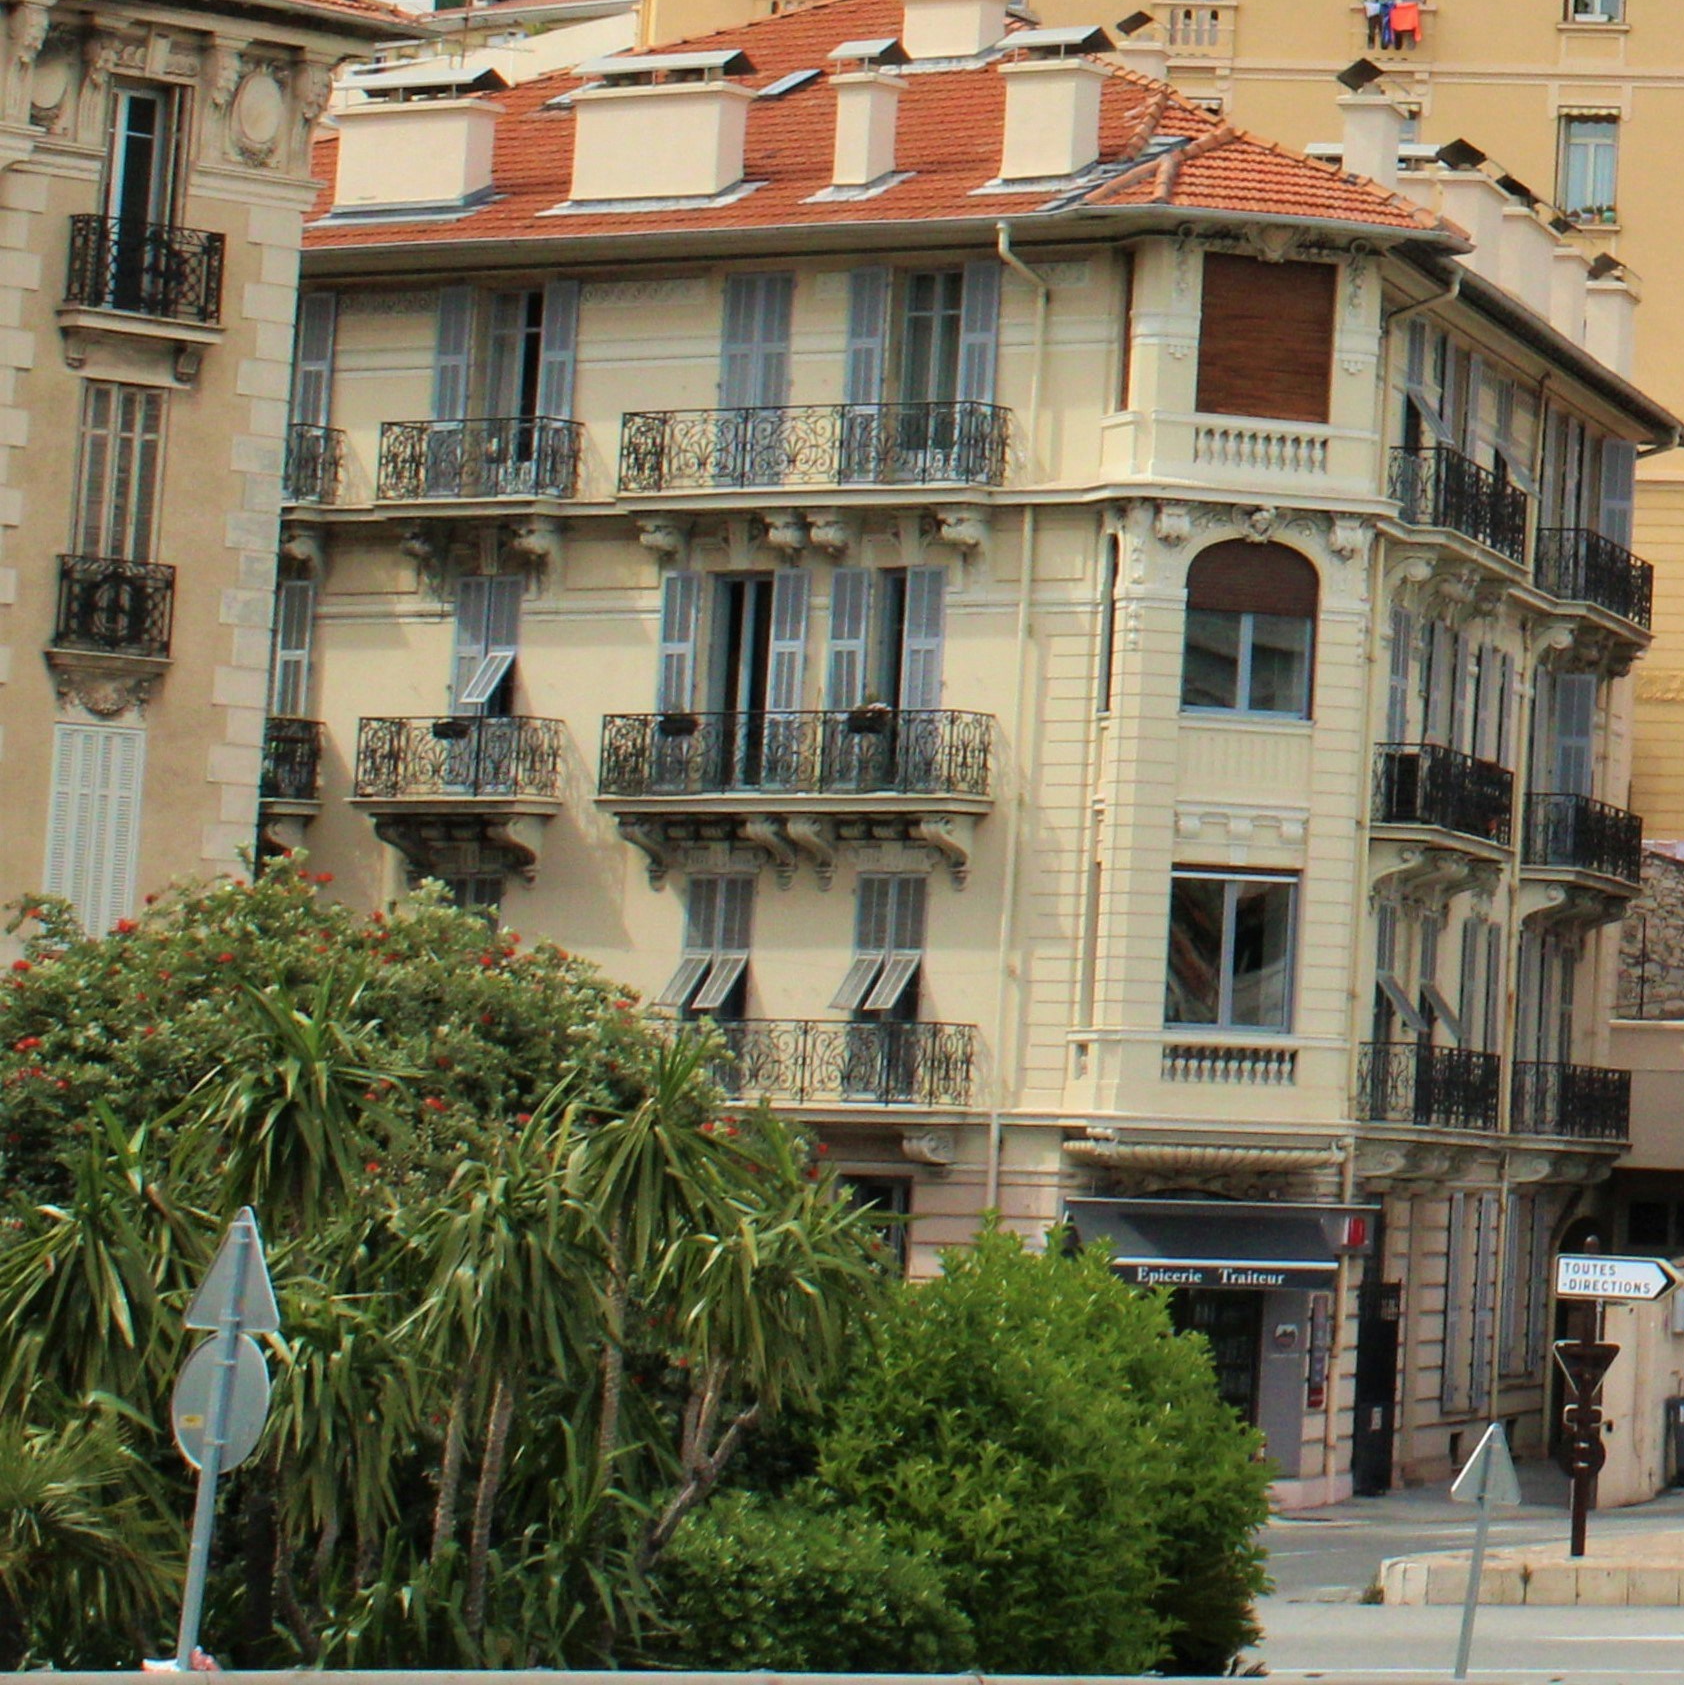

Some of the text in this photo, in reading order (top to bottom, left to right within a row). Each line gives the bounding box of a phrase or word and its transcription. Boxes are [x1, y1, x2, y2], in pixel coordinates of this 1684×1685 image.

[1136, 1266, 1285, 1286] Epicerie Traiteur
[1563, 1262, 1617, 1275] TOUTES
